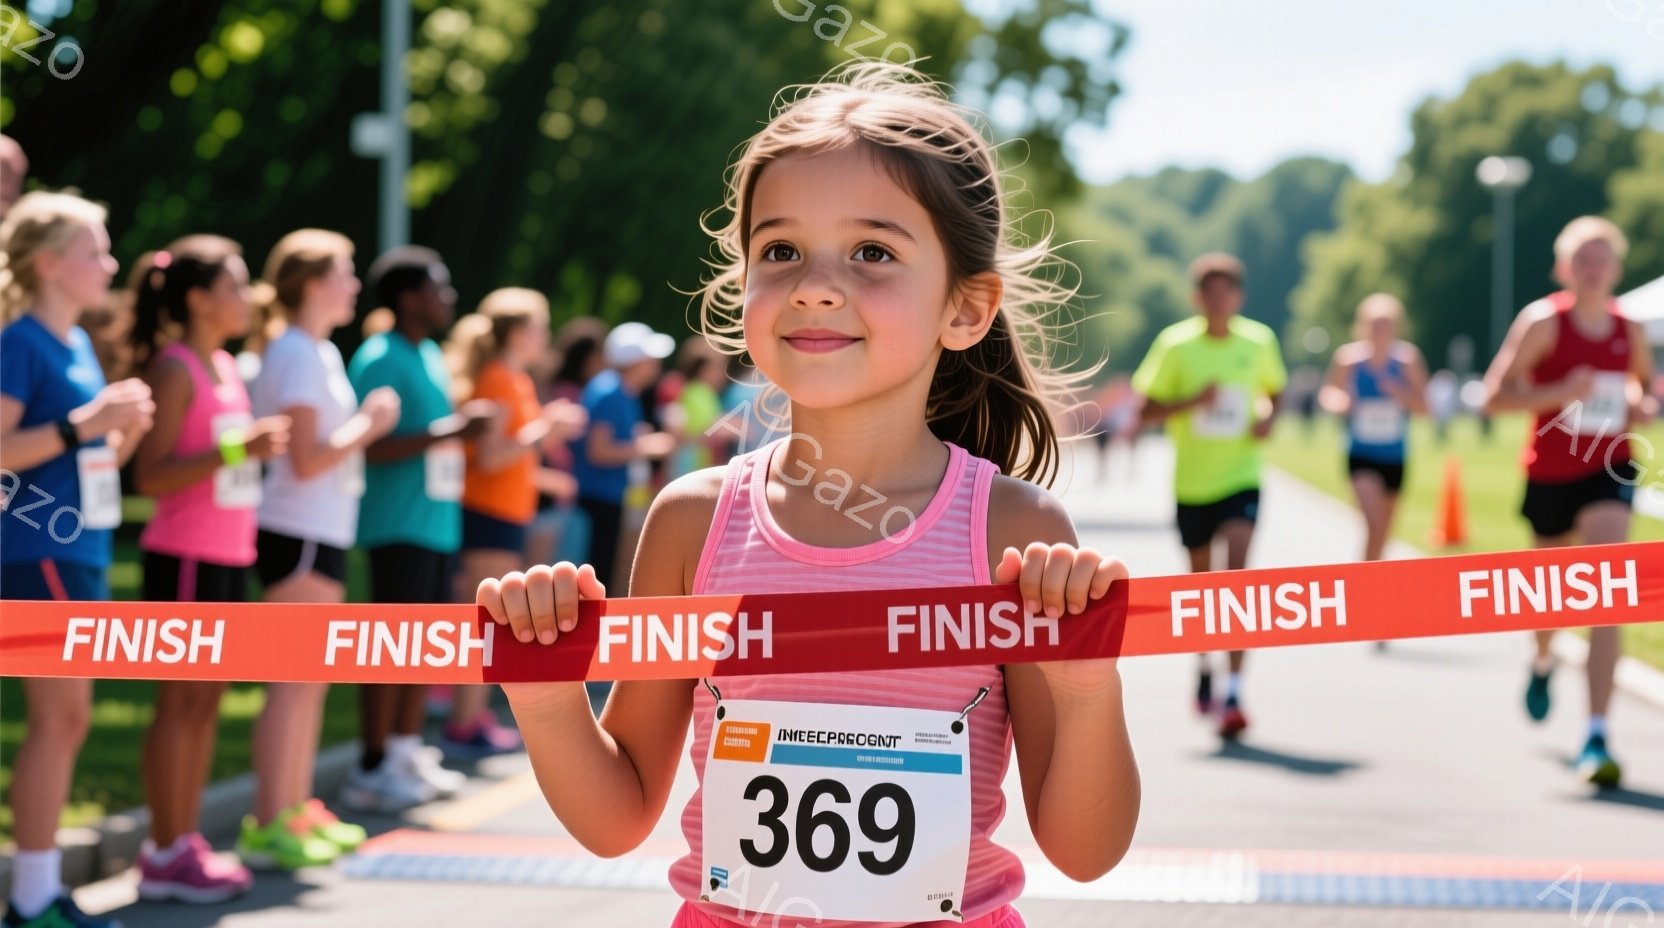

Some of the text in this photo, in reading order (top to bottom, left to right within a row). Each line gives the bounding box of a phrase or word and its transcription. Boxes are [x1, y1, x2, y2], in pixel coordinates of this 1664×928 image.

[62, 559, 1639, 667] FINISH FINISH FINISH FINISH FINISH FINISH
[740, 775, 916, 876] 369
